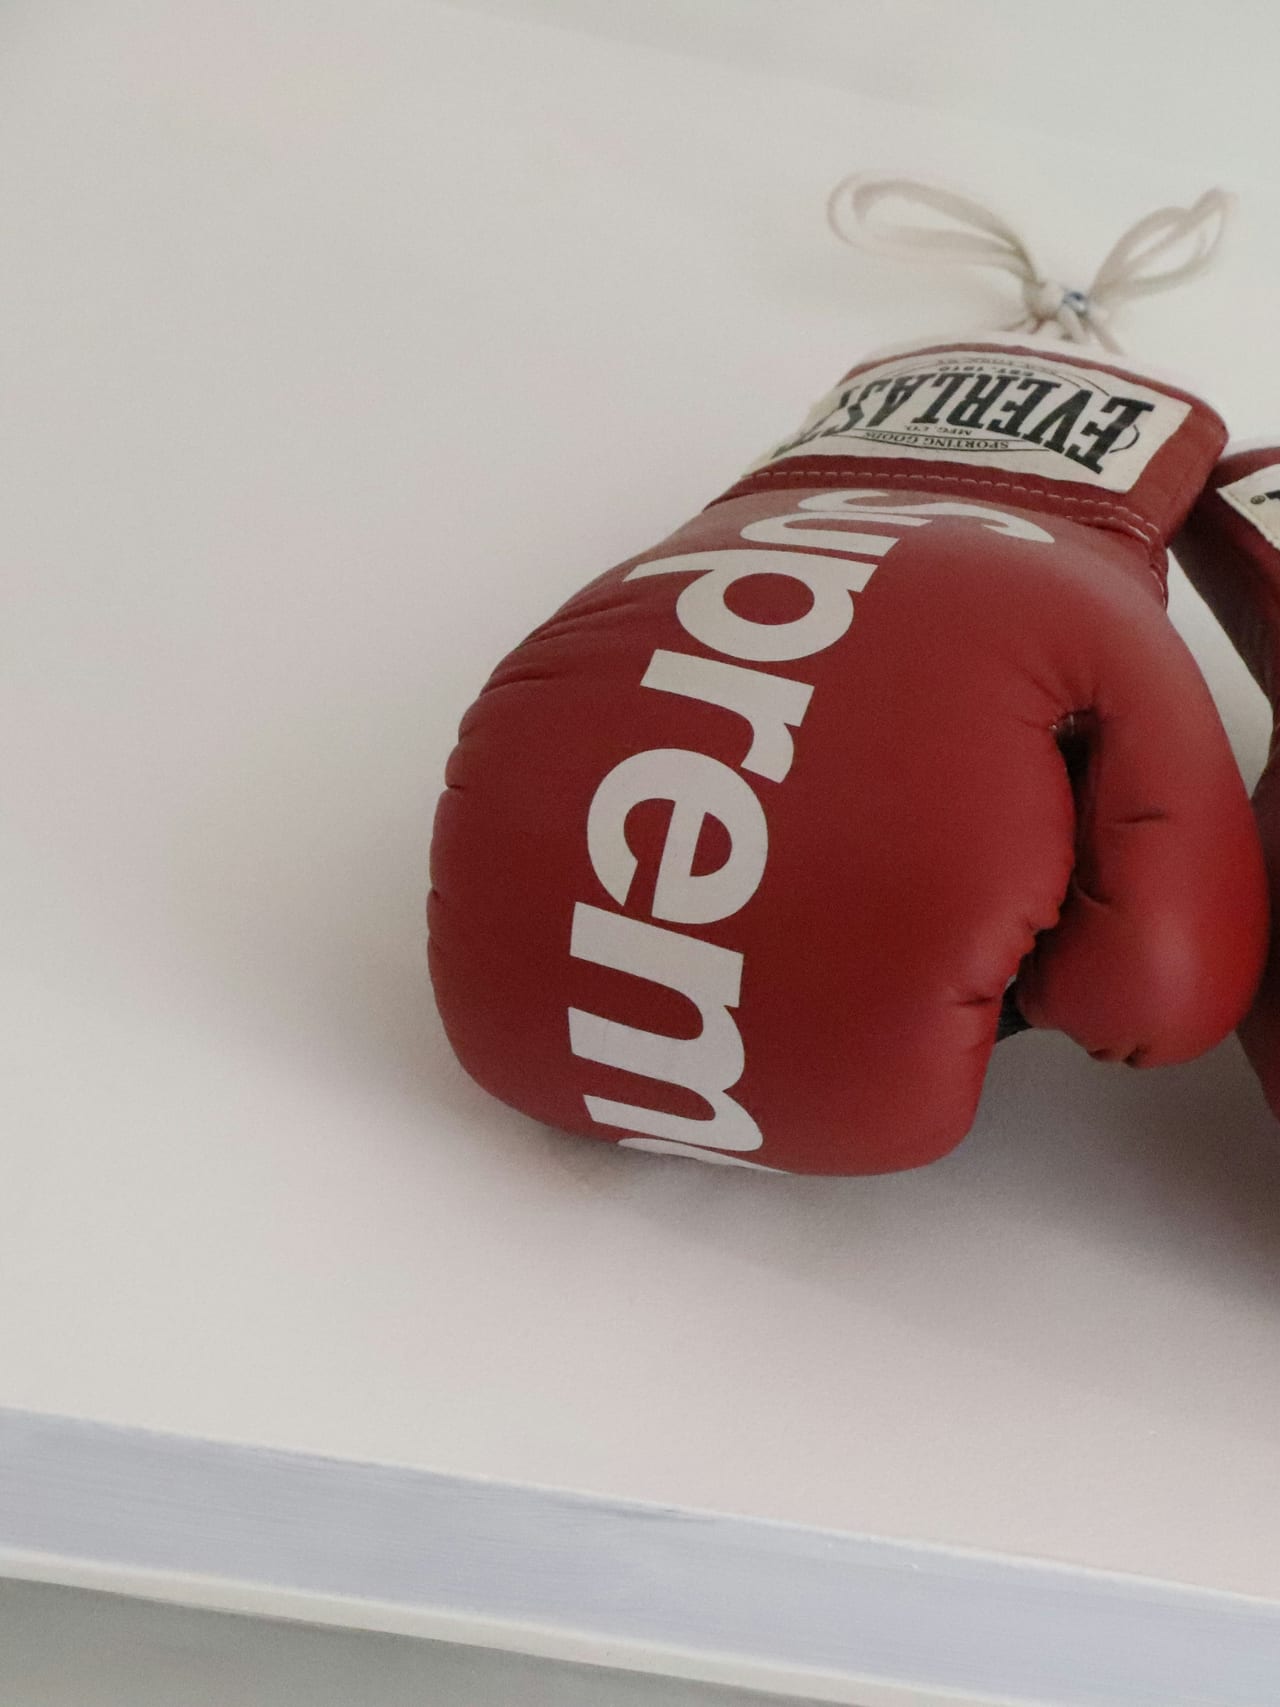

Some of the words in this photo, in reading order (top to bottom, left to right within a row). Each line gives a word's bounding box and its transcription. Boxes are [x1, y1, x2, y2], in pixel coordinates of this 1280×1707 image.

[866, 431, 918, 445] GOODS
[935, 427, 973, 436] MFG.
[923, 437, 1009, 449] SPORTING
[567, 489, 1056, 1176] Suprem
